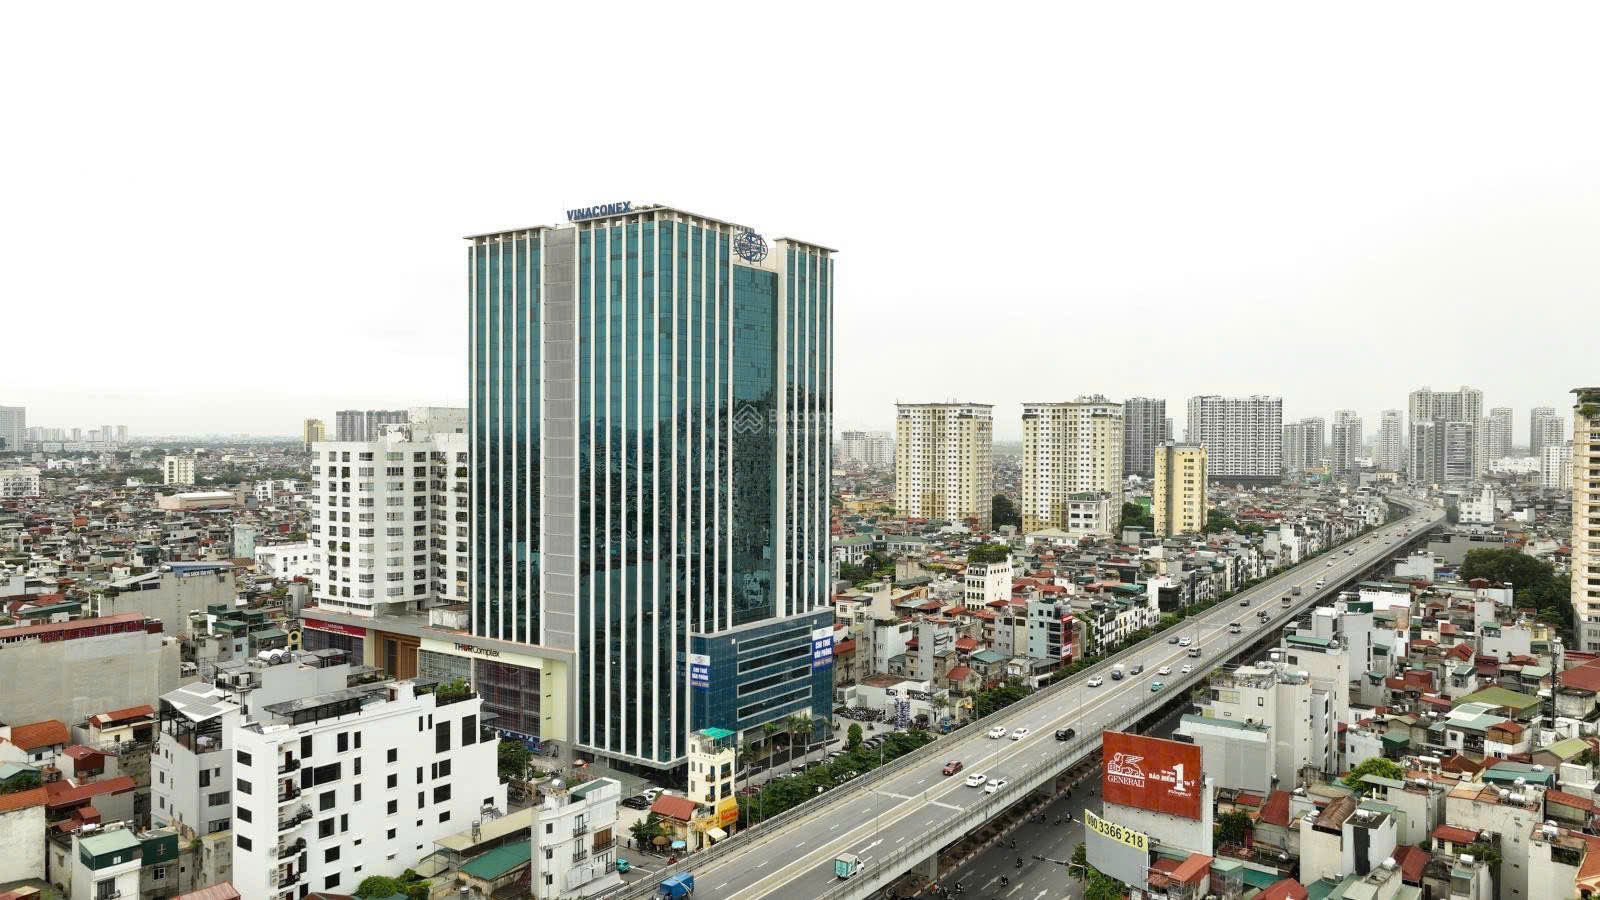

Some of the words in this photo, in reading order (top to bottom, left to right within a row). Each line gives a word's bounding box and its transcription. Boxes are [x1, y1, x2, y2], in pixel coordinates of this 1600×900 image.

[567, 200, 632, 221] VINACONEX
[1107, 774, 1145, 788] GENERALI
[1172, 763, 1186, 792] 1
[1099, 820, 1122, 840] 3366
[1125, 831, 1143, 848] 218
